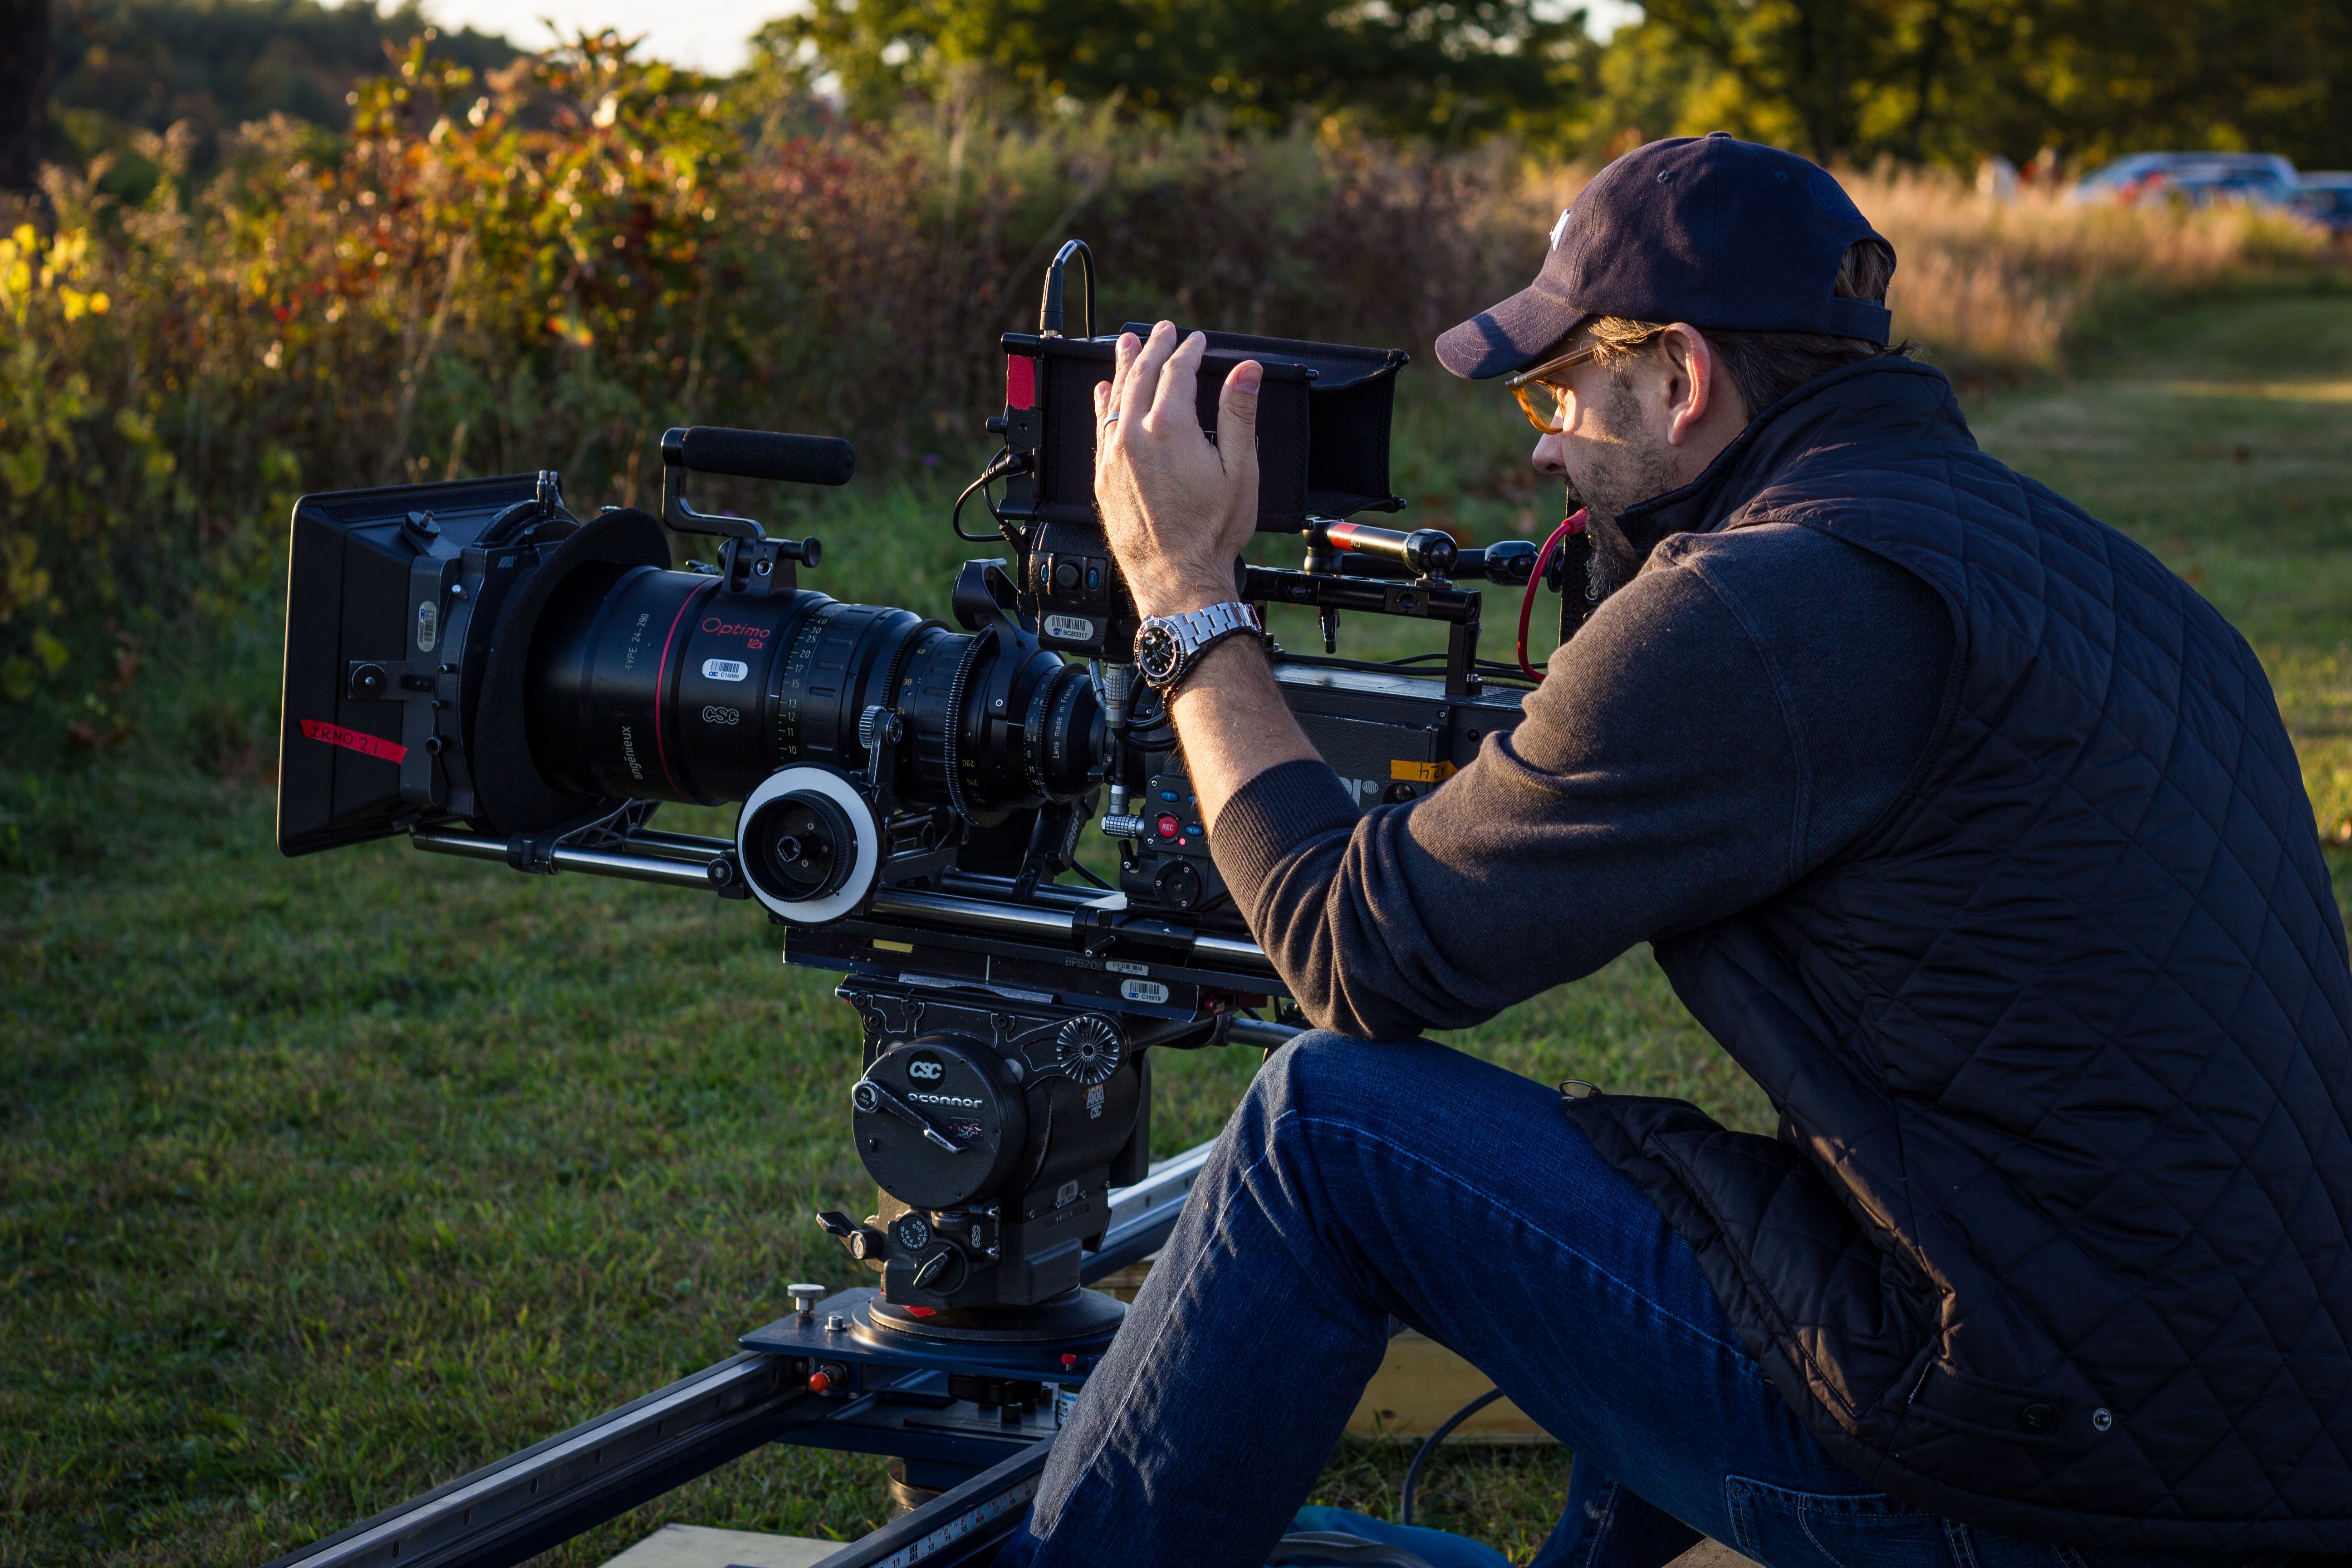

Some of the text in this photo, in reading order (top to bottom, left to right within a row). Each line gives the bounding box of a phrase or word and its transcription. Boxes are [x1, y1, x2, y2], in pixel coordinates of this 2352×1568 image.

[702, 617, 770, 638] Optimo
[1063, 630, 1088, 638] BCB3317
[625, 613, 649, 669] TYPE 24-290
[746, 638, 765, 650] 12x
[799, 650, 811, 658] 20
[795, 664, 804, 673] 17
[792, 679, 799, 688] 15
[1061, 684, 1075, 703] France
[789, 699, 796, 708] 13
[703, 706, 739, 725] CSC
[788, 712, 795, 721] 12
[787, 727, 793, 736] 11
[311, 726, 378, 755] IRND 2.1
[1027, 733, 1036, 742] 5.6
[622, 726, 643, 779] angénieux
[789, 745, 797, 755] 10
[962, 759, 975, 768] 290
[1162, 823, 1174, 831] REC
[1067, 818, 1079, 856] ARRI
[1066, 957, 1103, 971] BPB202
[910, 1061, 942, 1079] CSC
[1087, 1084, 1104, 1106] ARRI
[859, 1097, 870, 1105] LOCK
[1090, 1104, 1102, 1119] CSC
[912, 1224, 923, 1241] FLUID
[972, 1225, 980, 1248] CSC
[961, 1524, 967, 1533] 15
[945, 1533, 951, 1542] 14
[928, 1543, 934, 1551] 13
[892, 1557, 900, 1568] 11
